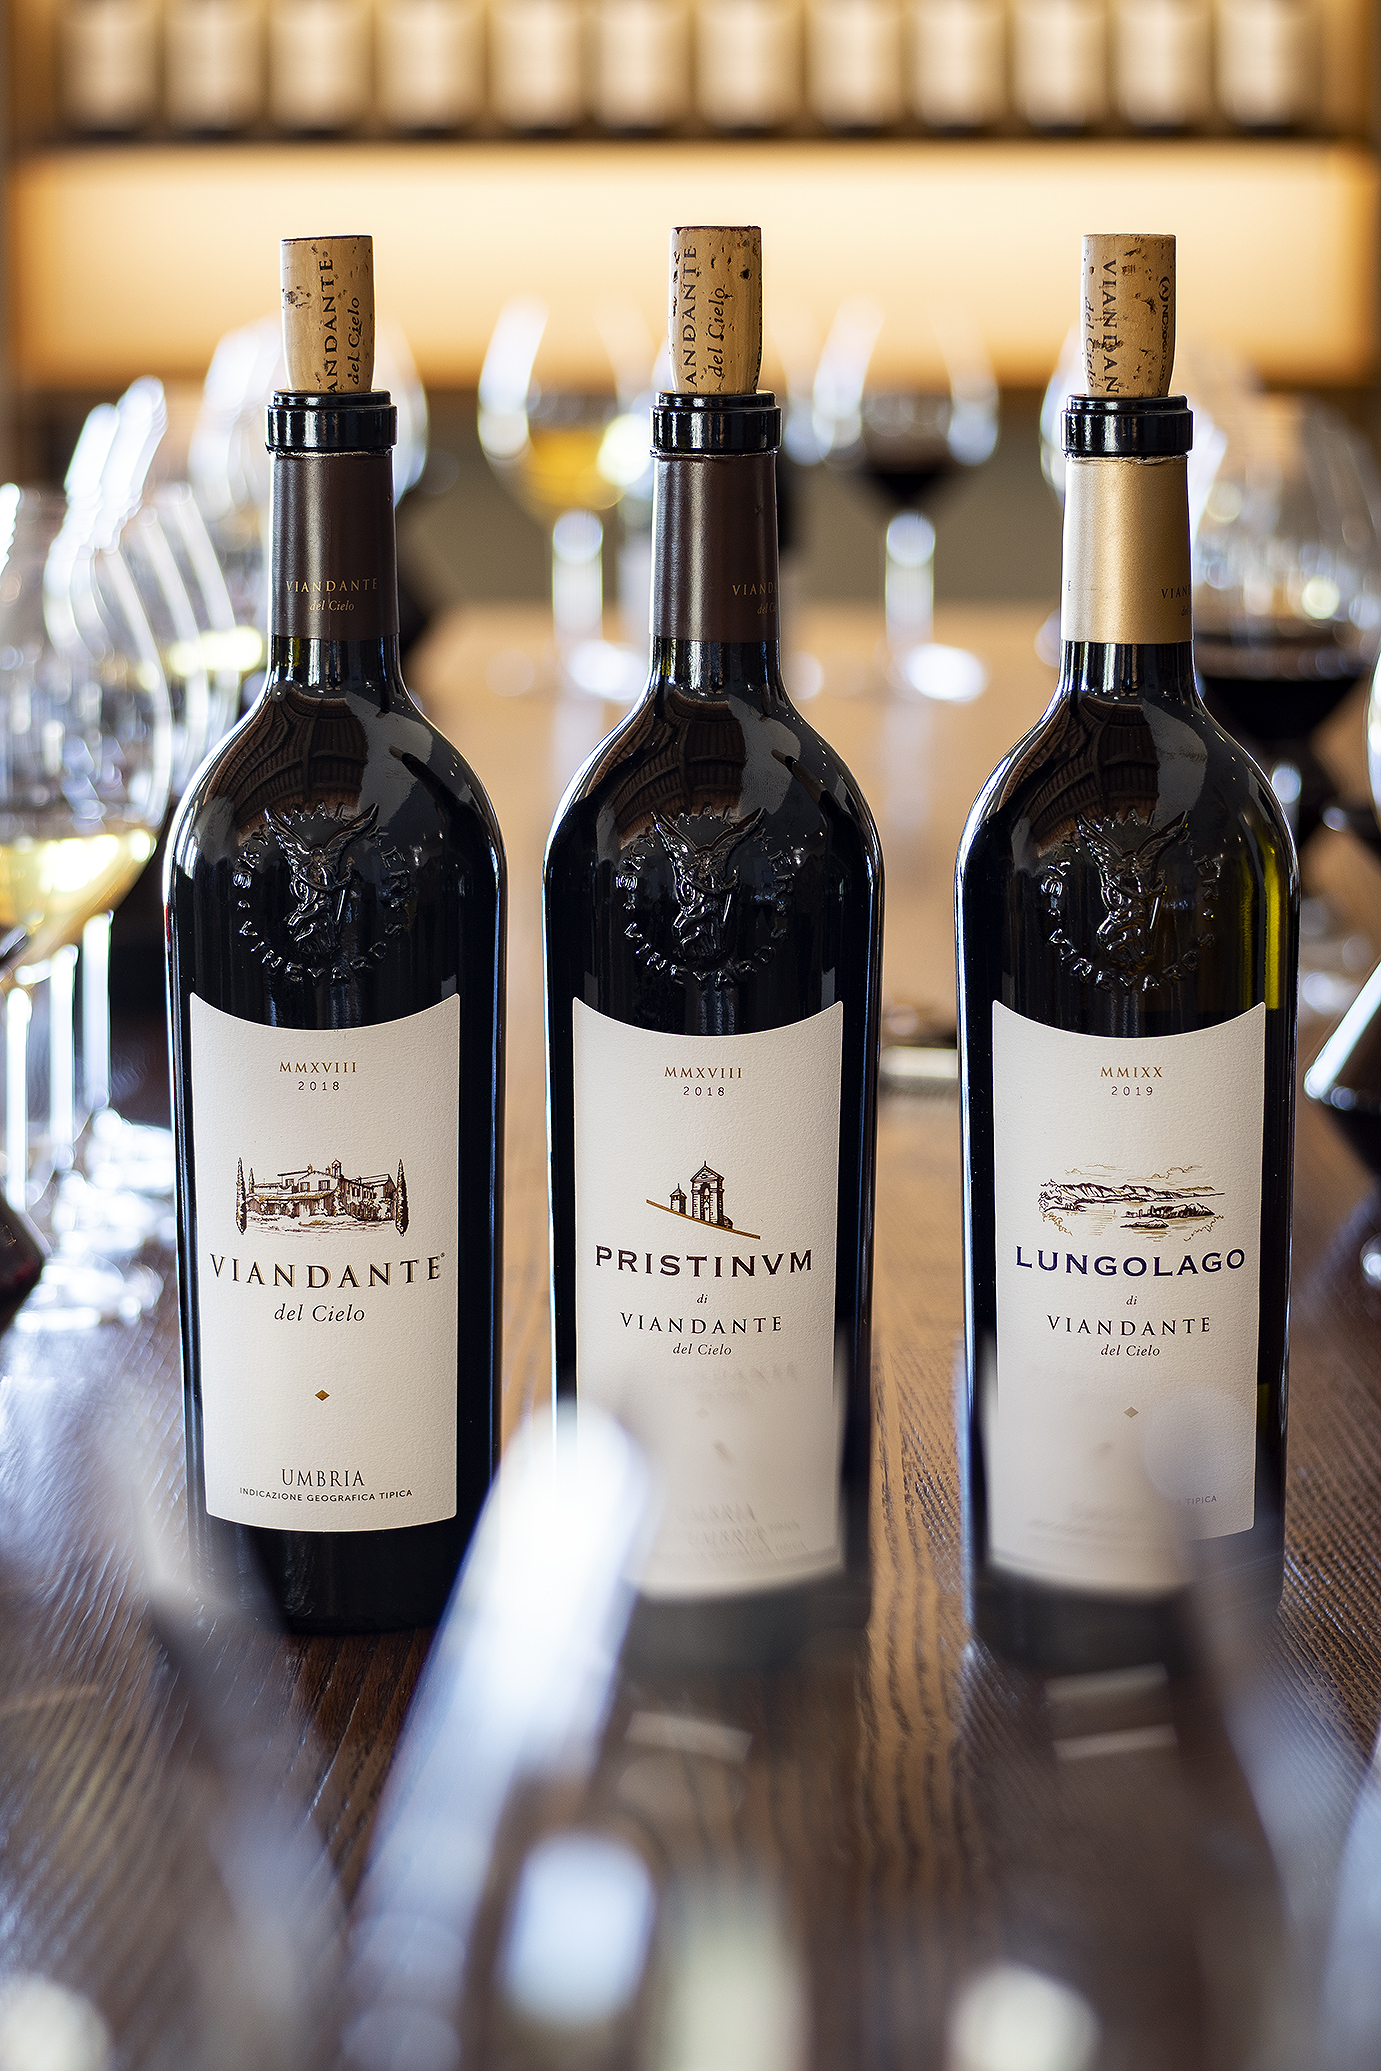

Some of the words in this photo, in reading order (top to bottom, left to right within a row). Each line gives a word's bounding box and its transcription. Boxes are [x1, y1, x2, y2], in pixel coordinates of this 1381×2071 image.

[683, 247, 698, 394] ANDANTE
[707, 287, 726, 341] Cielo
[347, 297, 363, 348] Cielo
[347, 350, 362, 385] del
[707, 346, 724, 378] del
[285, 577, 378, 593] VIANDANTE
[732, 581, 777, 596] VIAND
[309, 600, 326, 612] del
[328, 600, 355, 612] Cielo
[279, 1061, 357, 1074] MMXVIII
[664, 1066, 742, 1079] MMXVIII
[1100, 1066, 1163, 1078] MMIXX
[298, 1080, 340, 1092] 2018
[683, 1085, 725, 1097] 2018
[1111, 1085, 1153, 1097] 2019
[595, 1244, 813, 1278] PRISTINVM
[1015, 1245, 1246, 1278] LUNGOLAGO
[696, 1293, 709, 1305] di
[1125, 1294, 1138, 1306] di
[273, 1303, 303, 1322] del
[312, 1303, 366, 1323] Cielo
[620, 1311, 782, 1335] VIANDANTE
[1046, 1314, 1211, 1336] VIANDANTE
[672, 1343, 693, 1356] del
[697, 1343, 733, 1356] Cielo
[1100, 1344, 1121, 1357] del
[1126, 1344, 1161, 1357] Cielo
[281, 1468, 366, 1487] UMBRIA
[239, 1486, 303, 1502] INDICAZIONE
[306, 1493, 376, 1503] GEOGRAFICA
[379, 1489, 413, 1500] TIPICA
[1184, 1495, 1217, 1505] TIPICA
